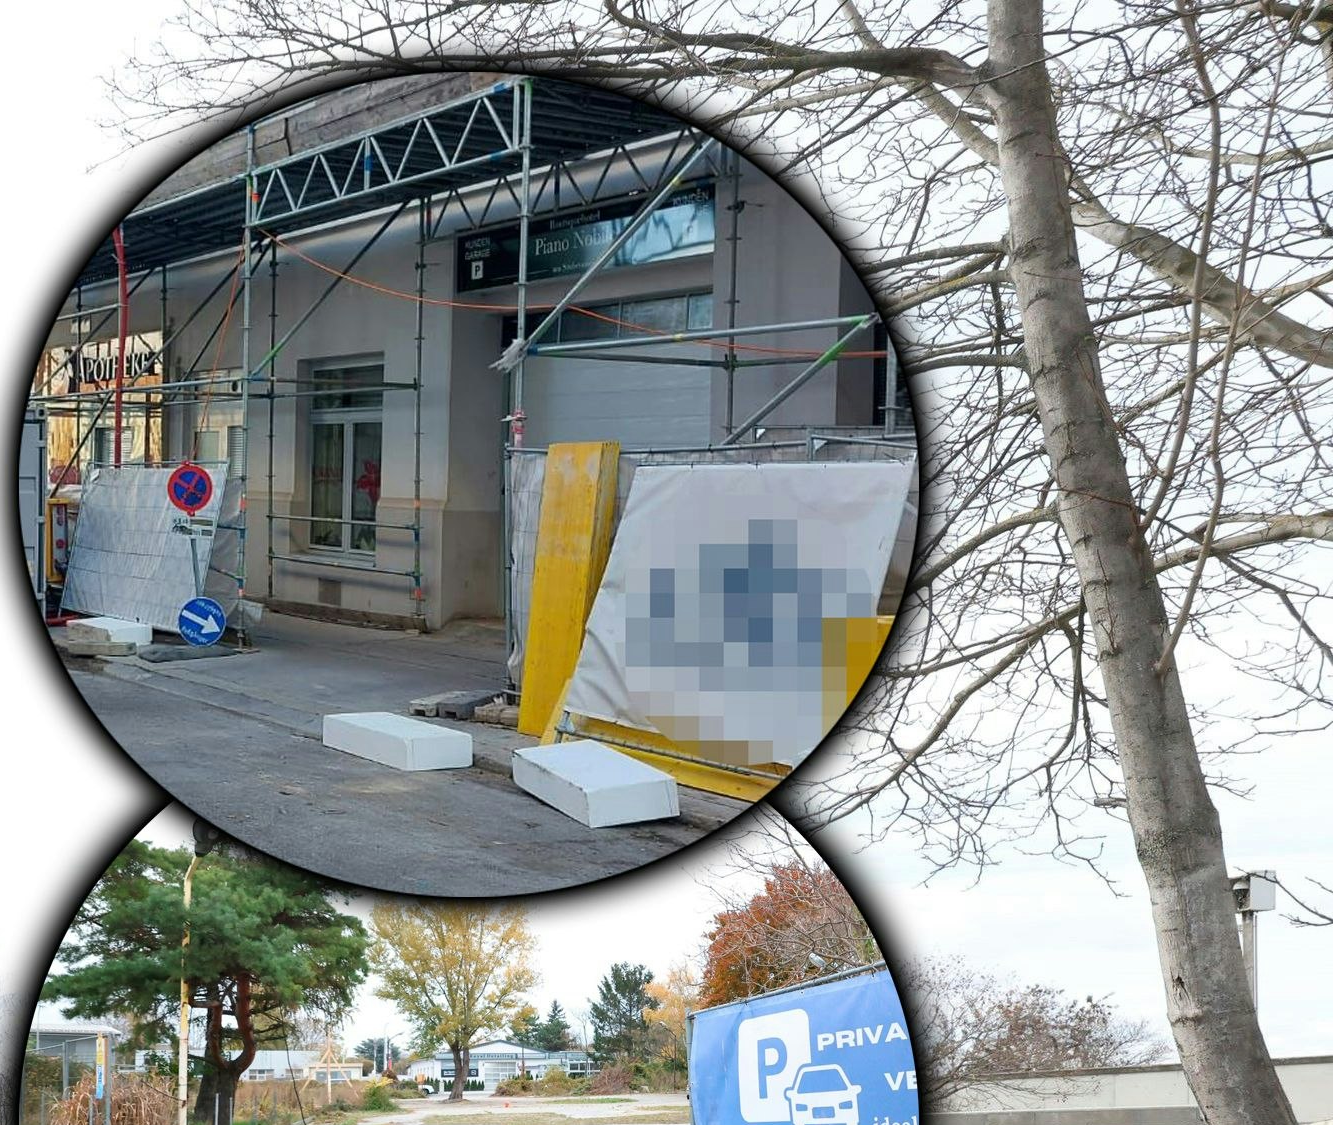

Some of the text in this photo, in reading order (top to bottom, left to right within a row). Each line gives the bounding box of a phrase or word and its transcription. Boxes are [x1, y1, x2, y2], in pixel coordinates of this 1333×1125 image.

[535, 226, 613, 256] Piano Nobil
[757, 1037, 788, 1099] P
